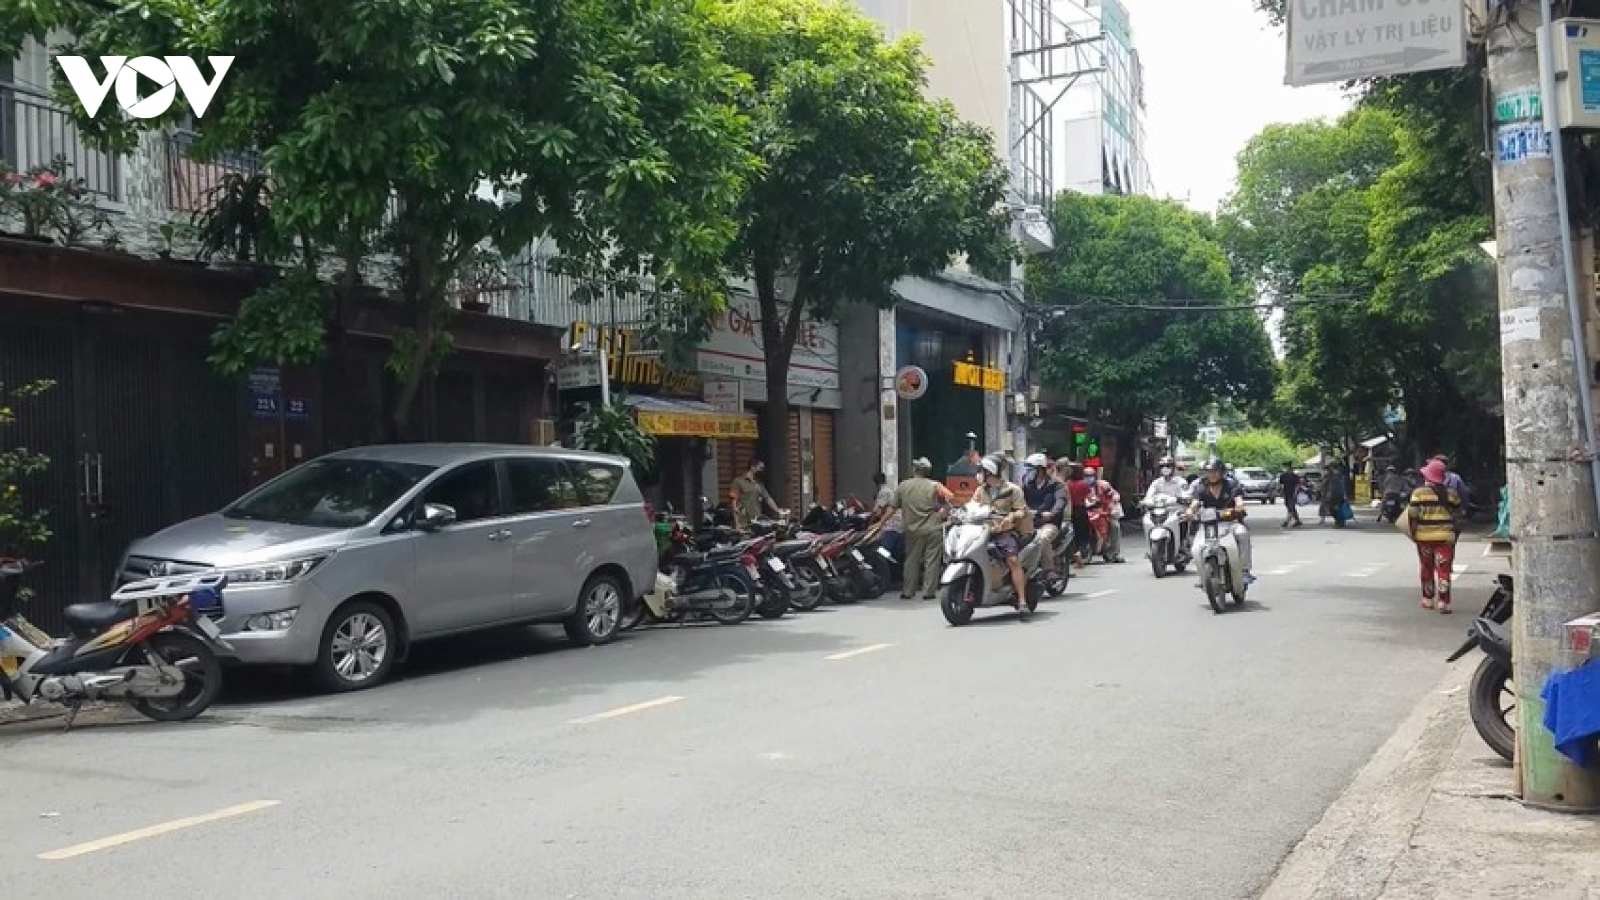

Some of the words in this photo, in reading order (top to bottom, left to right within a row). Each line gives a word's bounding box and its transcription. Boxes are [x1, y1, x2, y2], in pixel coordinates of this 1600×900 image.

[1304, 30, 1339, 53] VẬT
[1344, 24, 1367, 46] LÝ
[1374, 23, 1403, 43] TRỊ
[1409, 13, 1453, 38] LIỆU
